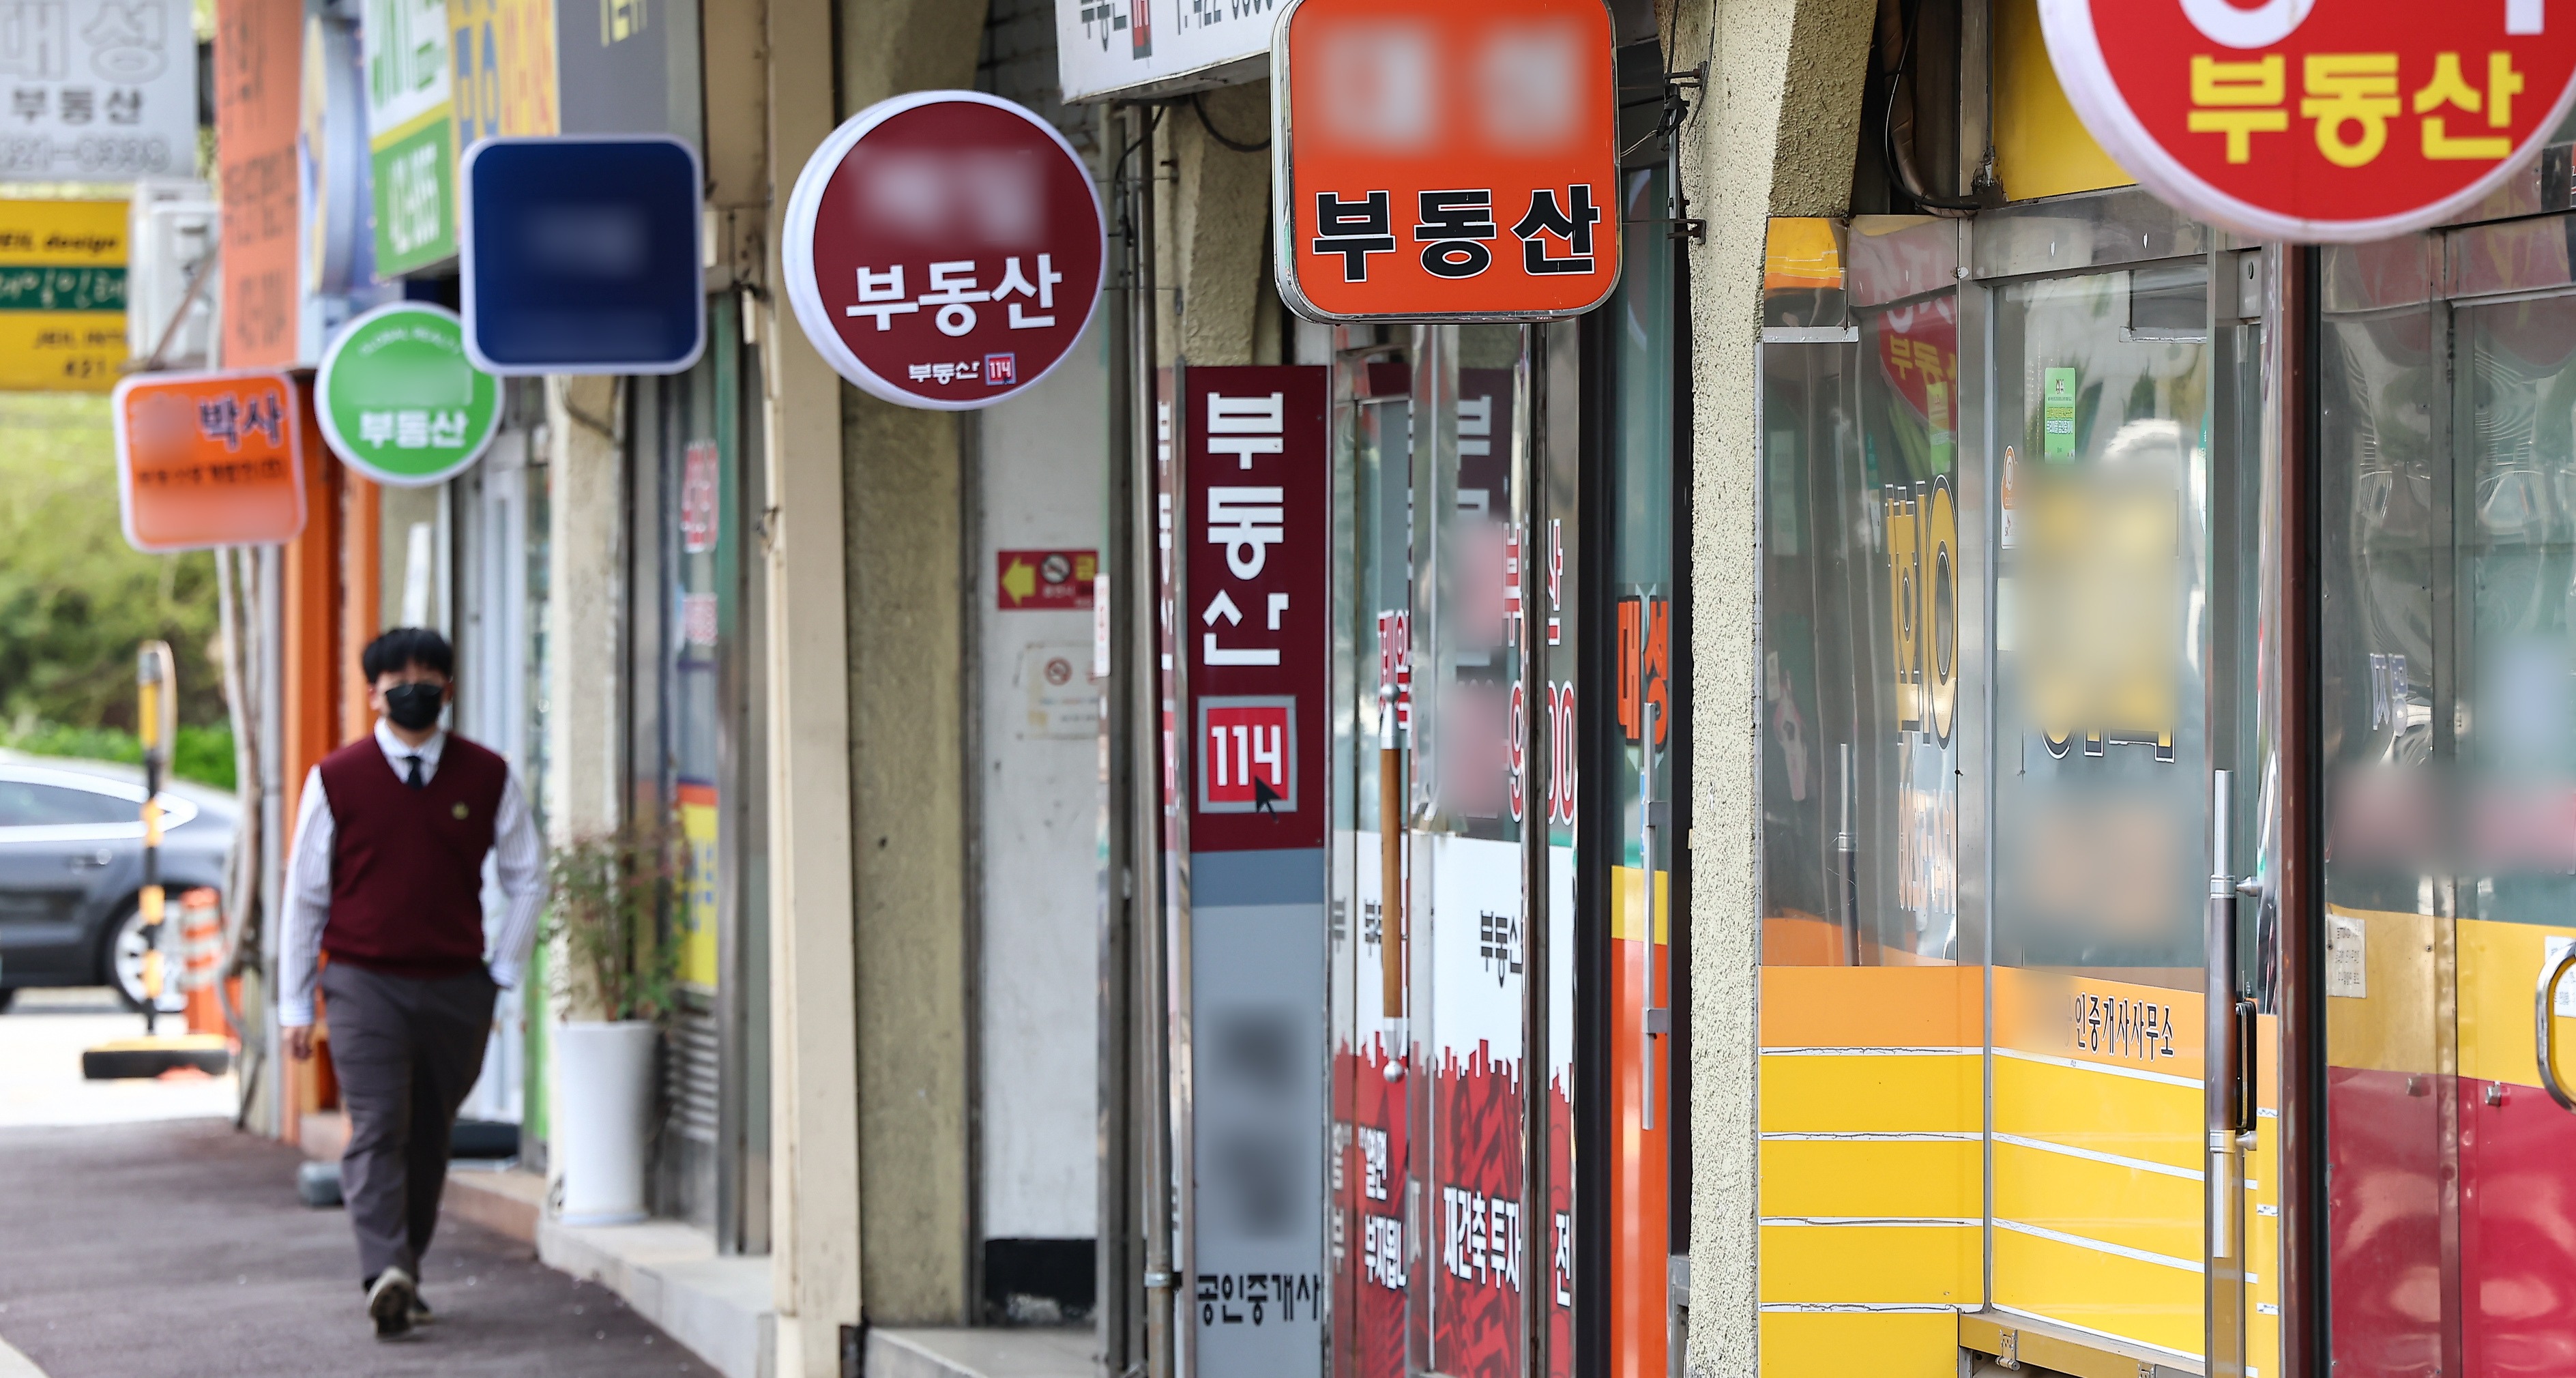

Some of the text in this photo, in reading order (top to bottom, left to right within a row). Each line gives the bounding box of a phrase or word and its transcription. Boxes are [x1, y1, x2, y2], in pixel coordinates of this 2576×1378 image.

[12, 89, 143, 126] 부동산
[2186, 51, 2524, 168] 부동산
[1311, 184, 1602, 283] 부동산
[845, 252, 1063, 336] 부동산
[908, 361, 1012, 385] 부동산 114
[199, 392, 284, 449] 박사
[360, 410, 471, 449] 부동산
[1203, 392, 1289, 787] 부동산 114
[1618, 596, 1669, 754] 대성
[2063, 991, 2175, 1063] 인중개사사무소
[1444, 1187, 1571, 1308] 재건축 투자 전
[1197, 1274, 1321, 1326] 공인중개사
